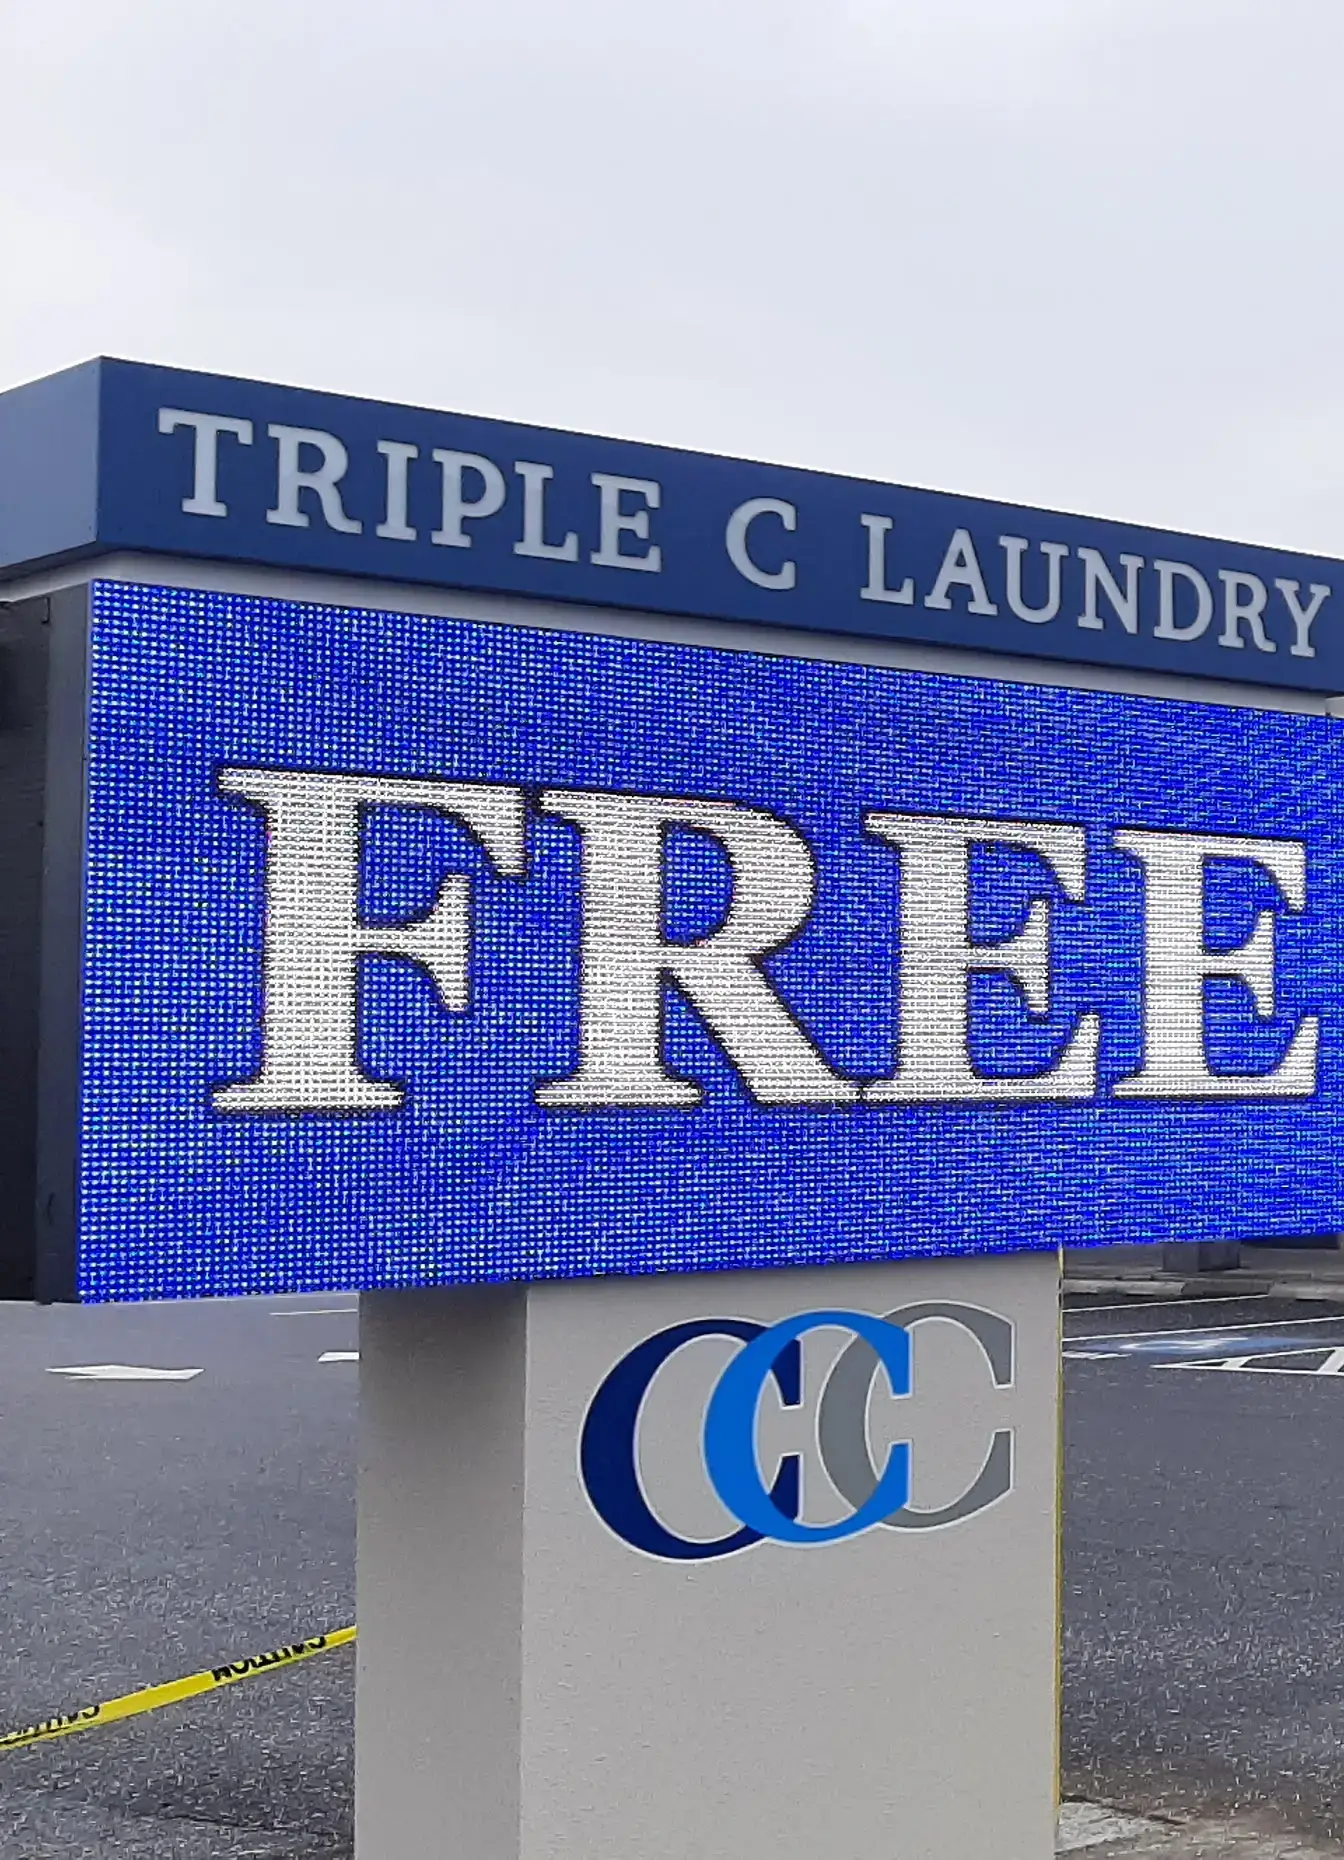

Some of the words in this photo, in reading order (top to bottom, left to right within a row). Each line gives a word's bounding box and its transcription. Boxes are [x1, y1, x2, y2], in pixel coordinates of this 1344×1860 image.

[159, 406, 663, 573] TRIPLE
[726, 498, 797, 590] C
[860, 513, 1332, 660] LAUNDRY
[211, 764, 1324, 1118] FREE
[576, 1300, 1016, 1563] CCC
